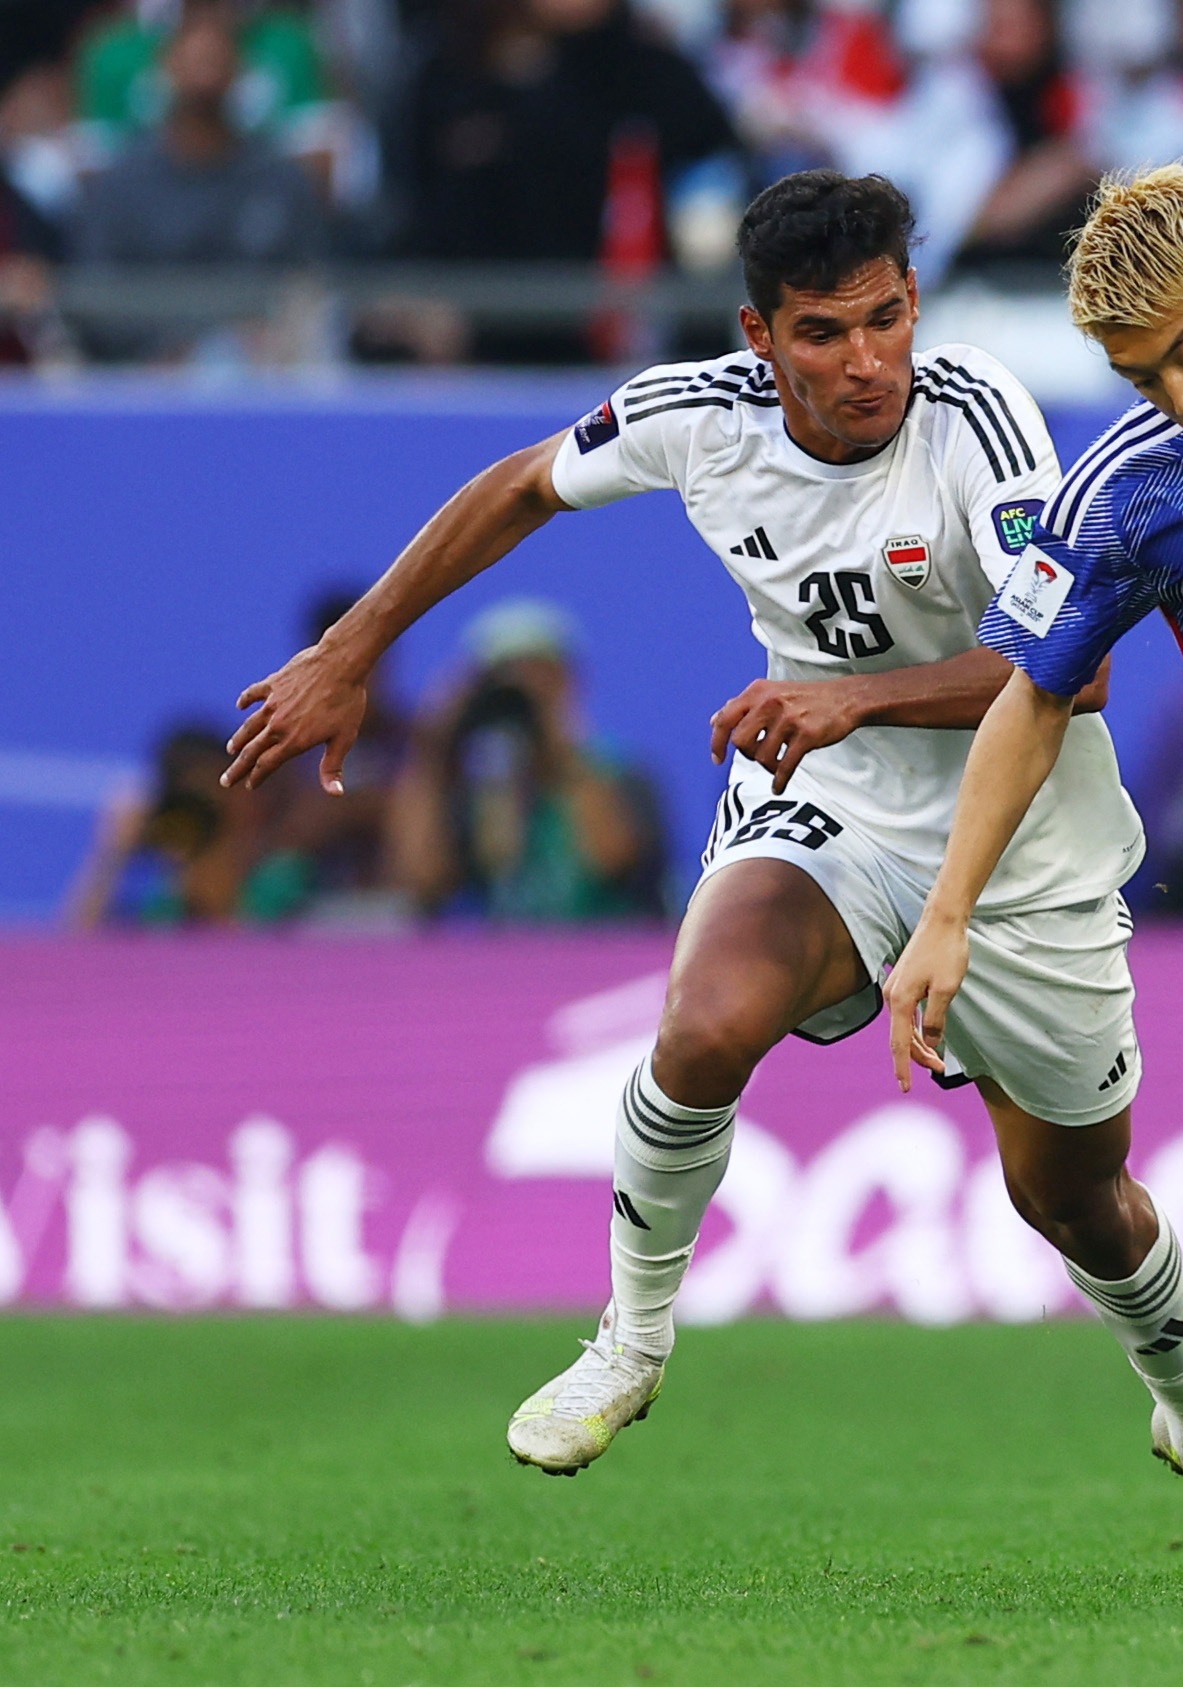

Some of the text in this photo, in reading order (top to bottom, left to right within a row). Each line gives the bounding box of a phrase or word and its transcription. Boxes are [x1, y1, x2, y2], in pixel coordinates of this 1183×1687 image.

[1001, 507, 1026, 520] AFC
[1002, 515, 1038, 536] LIV
[890, 539, 919, 548] IRAQ
[1006, 532, 1034, 545] LIV
[799, 572, 896, 660] 25
[725, 800, 844, 851] 25
